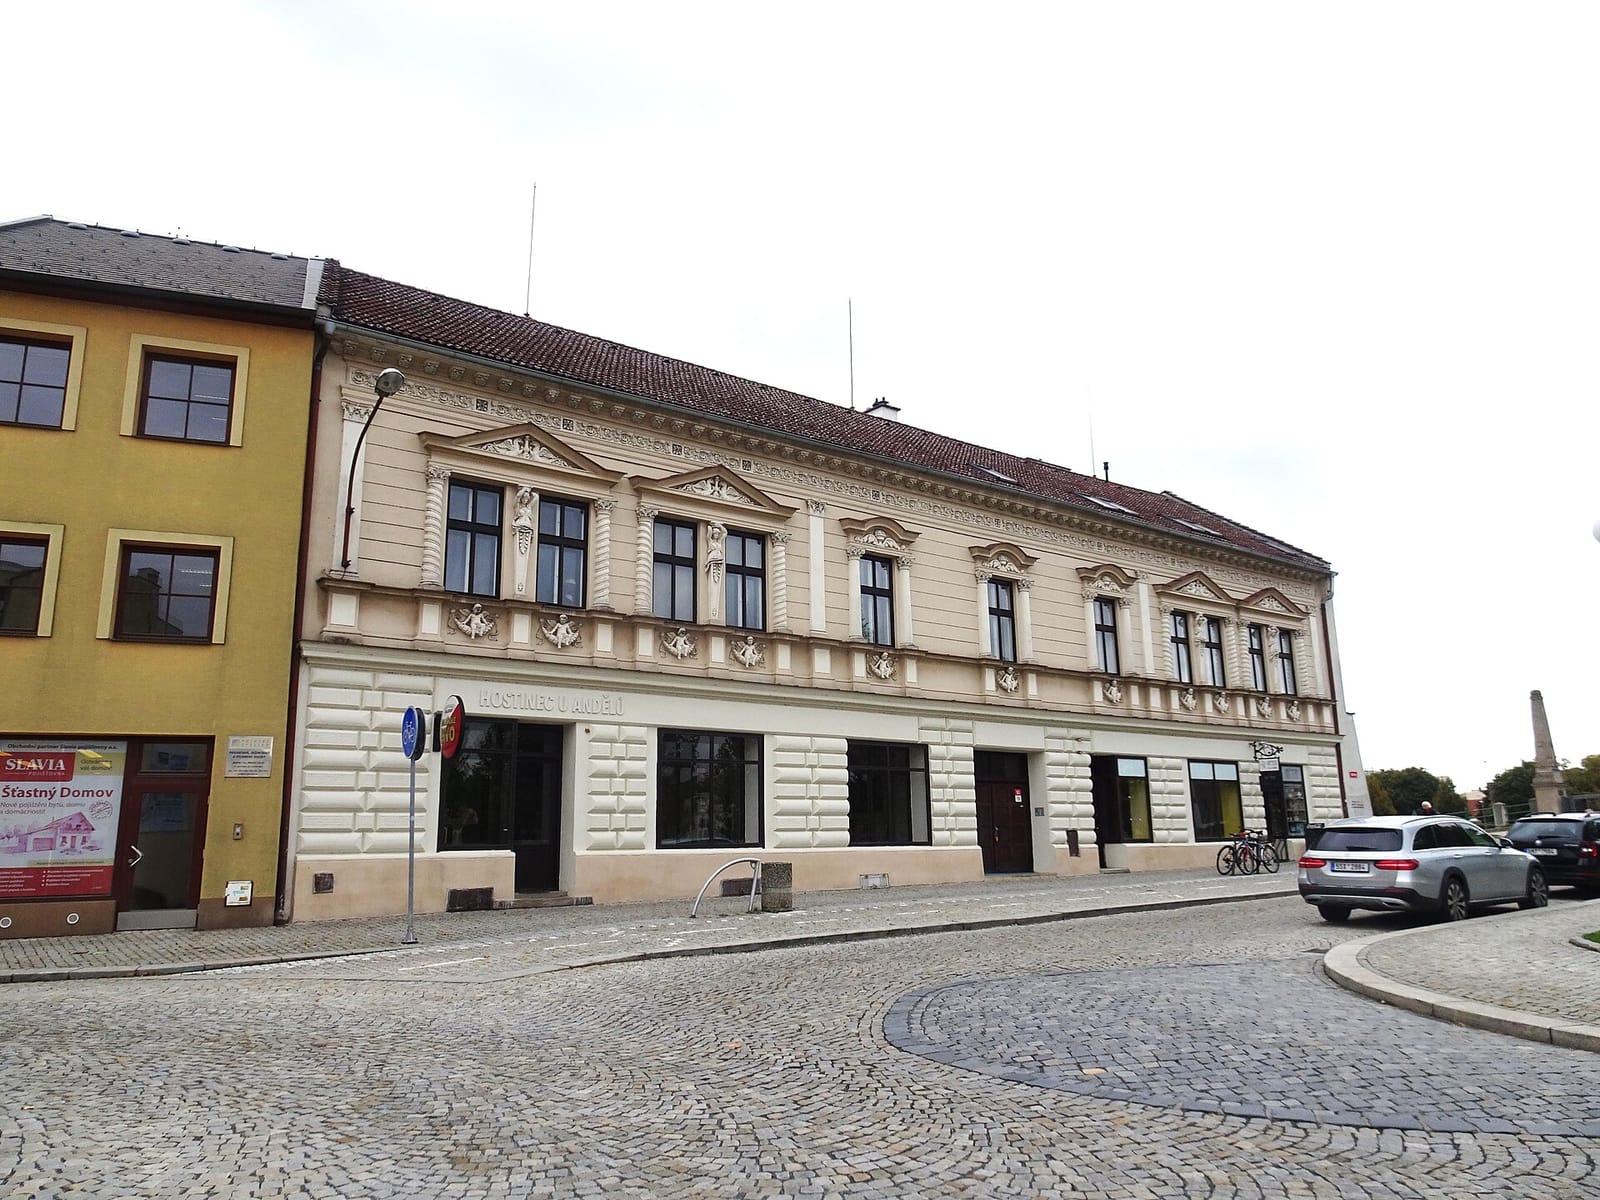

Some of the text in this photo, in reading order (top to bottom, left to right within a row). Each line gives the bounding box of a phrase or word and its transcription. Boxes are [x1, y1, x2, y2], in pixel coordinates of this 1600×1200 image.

[479, 690, 555, 711] HOSTINEC
[558, 695, 568, 712] U
[5, 758, 65, 771] SLAVIA
[2, 785, 114, 800] Šťastný Domov
[18, 801, 47, 809] pojištění
